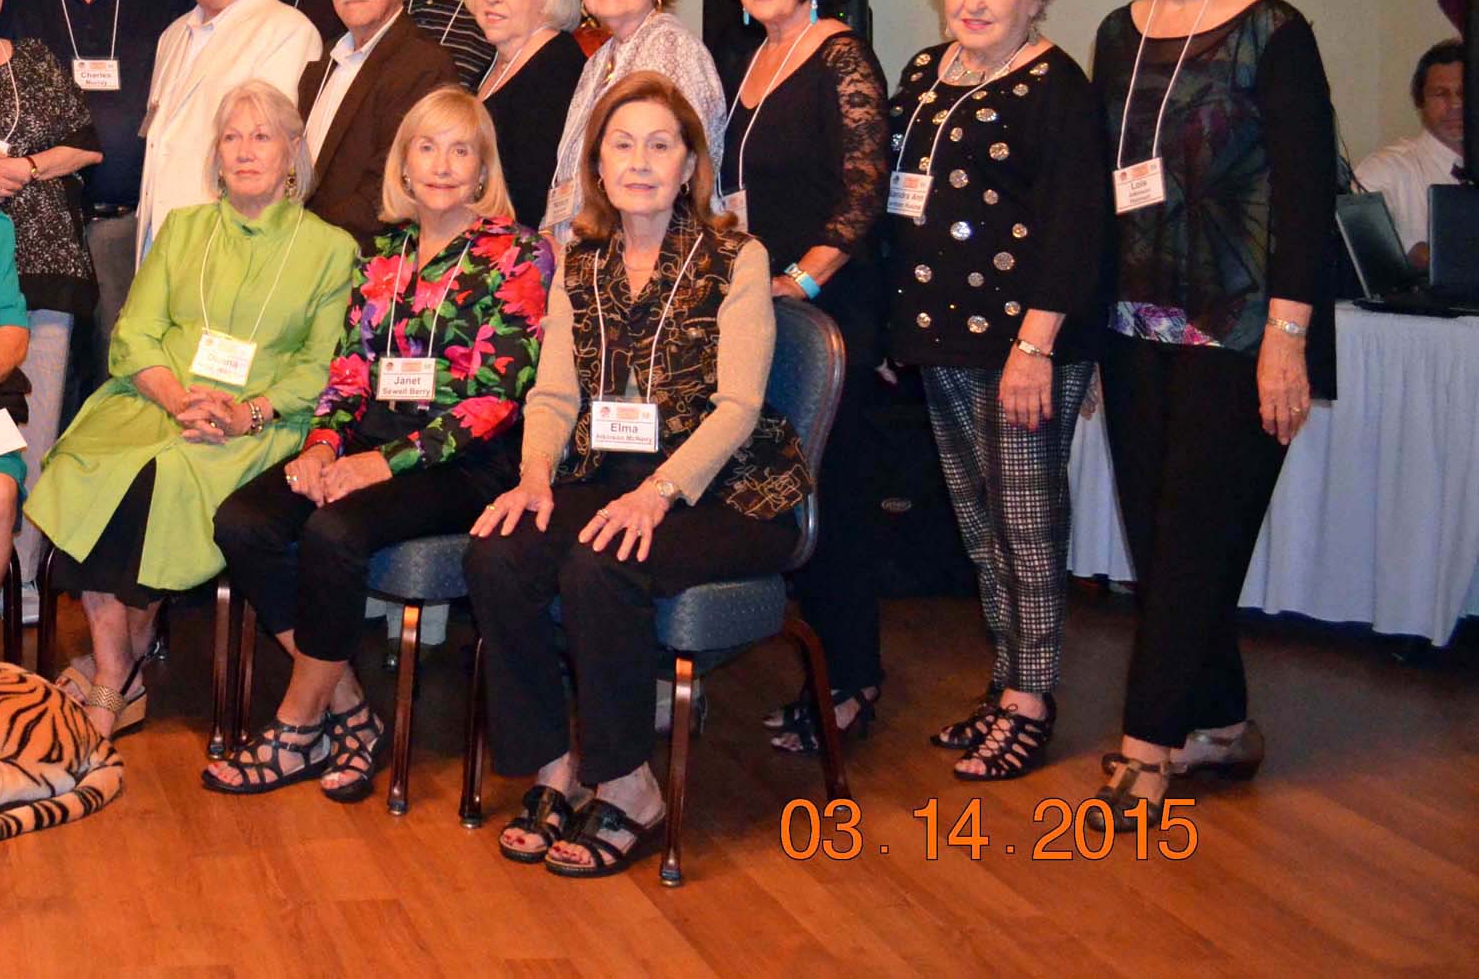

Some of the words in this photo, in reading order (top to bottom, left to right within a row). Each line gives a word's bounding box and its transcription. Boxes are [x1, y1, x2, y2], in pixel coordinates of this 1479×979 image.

[80, 71, 113, 79] Charles
[1130, 180, 1147, 190] Lois
[393, 375, 422, 385] Janet
[409, 387, 431, 396] Berry
[610, 422, 639, 434] Elma
